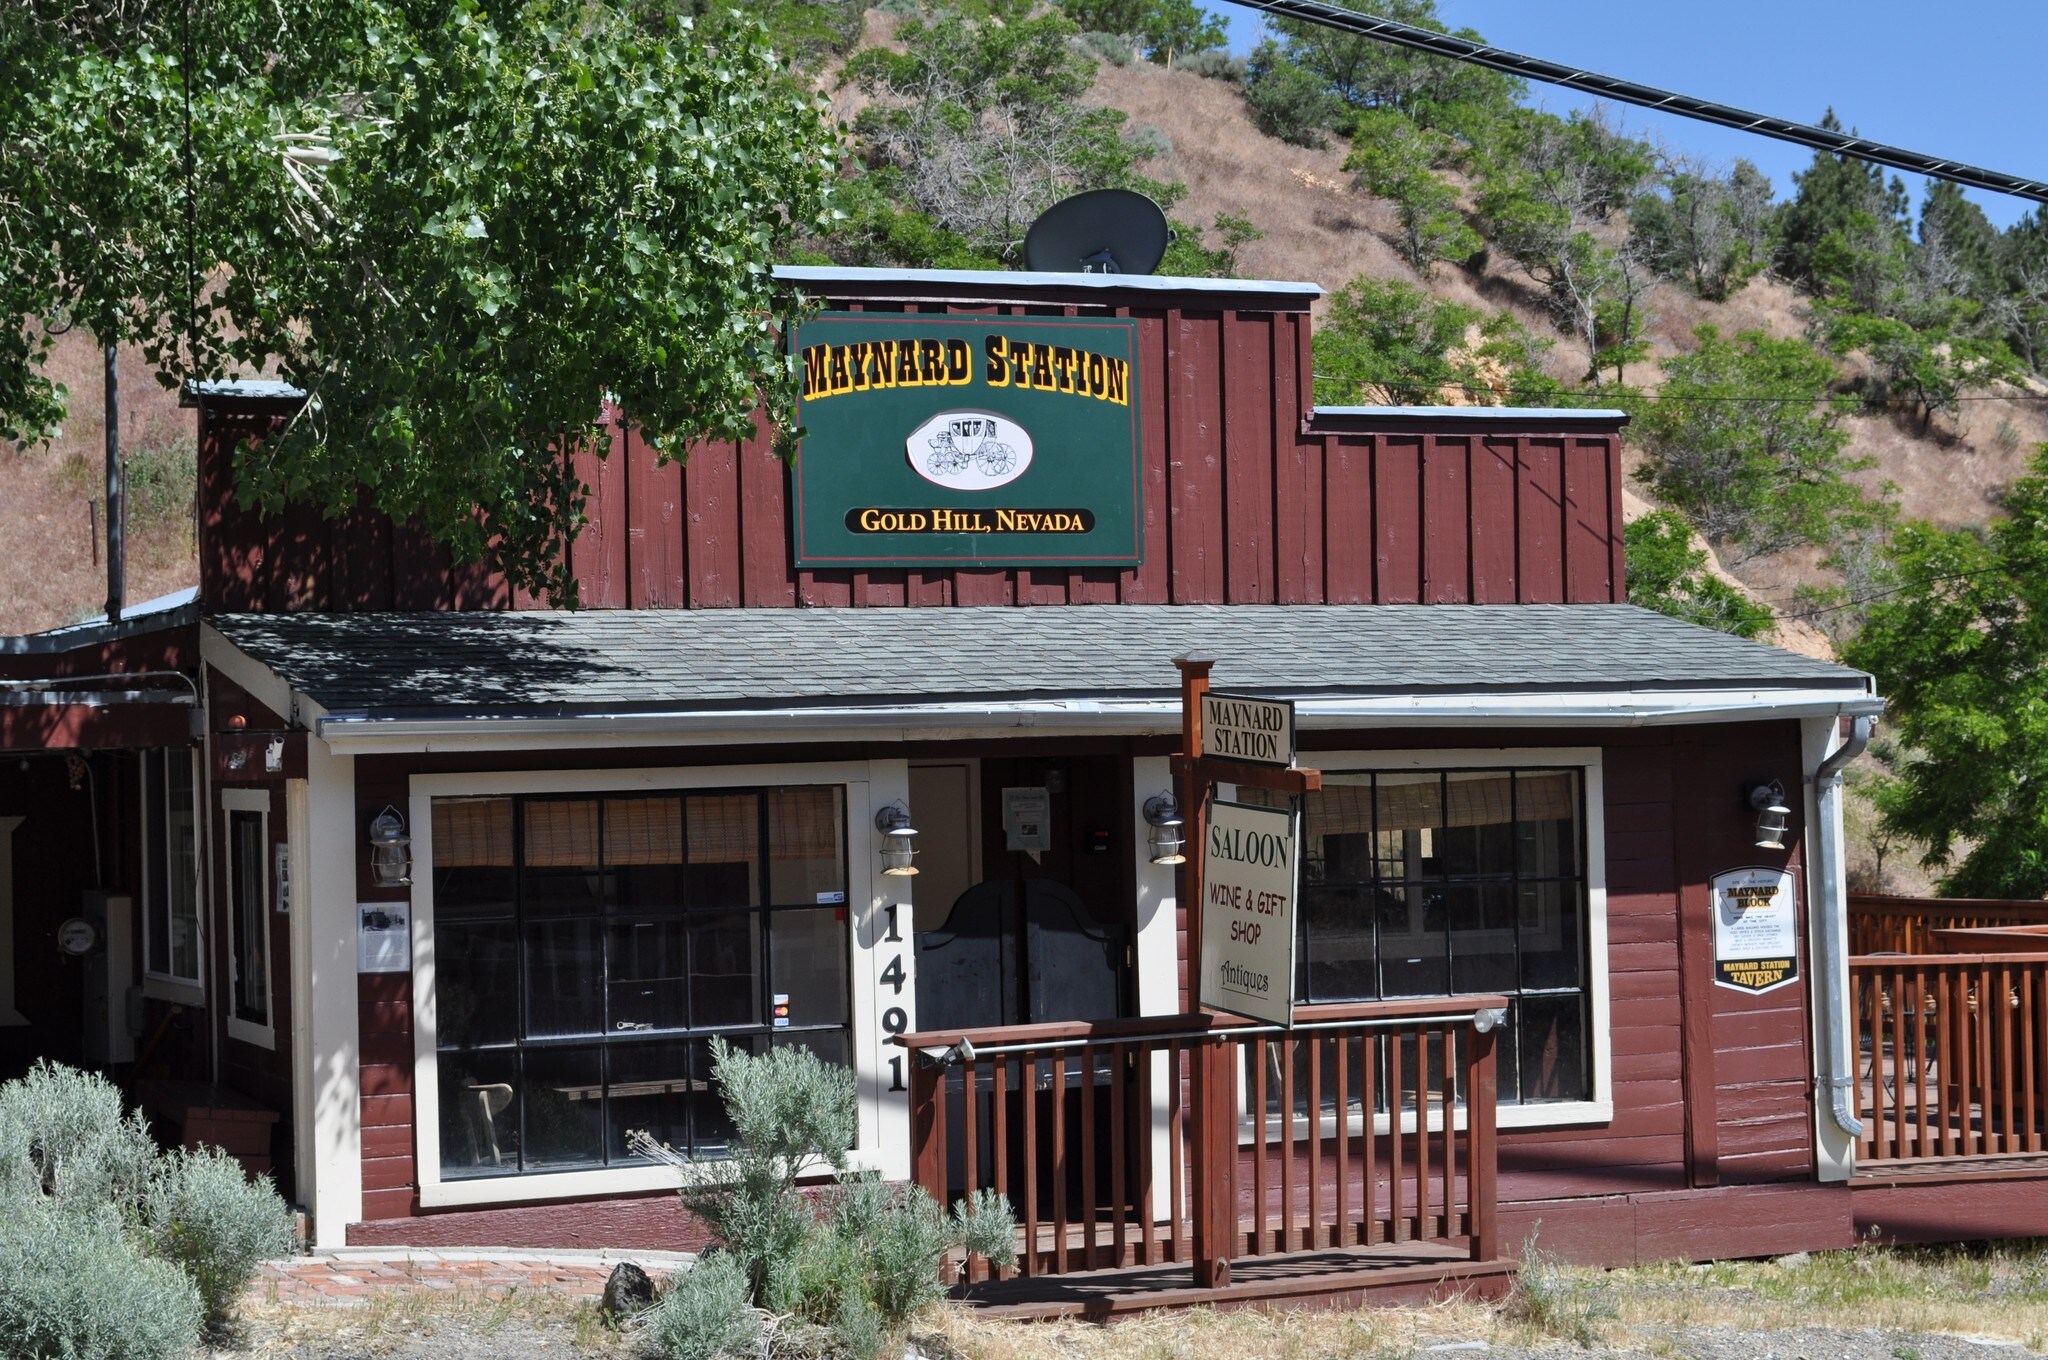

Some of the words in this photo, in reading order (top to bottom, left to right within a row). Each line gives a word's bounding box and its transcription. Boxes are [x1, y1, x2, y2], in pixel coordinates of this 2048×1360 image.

[802, 338, 971, 401] MAYNARD
[985, 335, 1128, 406] STATION
[860, 509, 926, 531] GOLD
[932, 509, 991, 533] HILL,
[996, 510, 1085, 531] NEVADA
[1209, 701, 1283, 732] MAYNARD
[1214, 728, 1277, 760] STATION
[1211, 825, 1288, 870] SALOON
[1210, 882, 1241, 909] WINE
[1246, 889, 1253, 912] &
[1257, 892, 1286, 918] GIFT
[1727, 886, 1779, 898] MAYNARD
[1736, 898, 1771, 909] BLOCK
[1230, 920, 1261, 945] SHOP
[1221, 960, 1269, 994] Antiques
[1723, 962, 1758, 971] MAYNARD
[1761, 960, 1790, 969] STATION
[1731, 970, 1783, 987] TAVERN
[880, 904, 908, 1092] 1491
